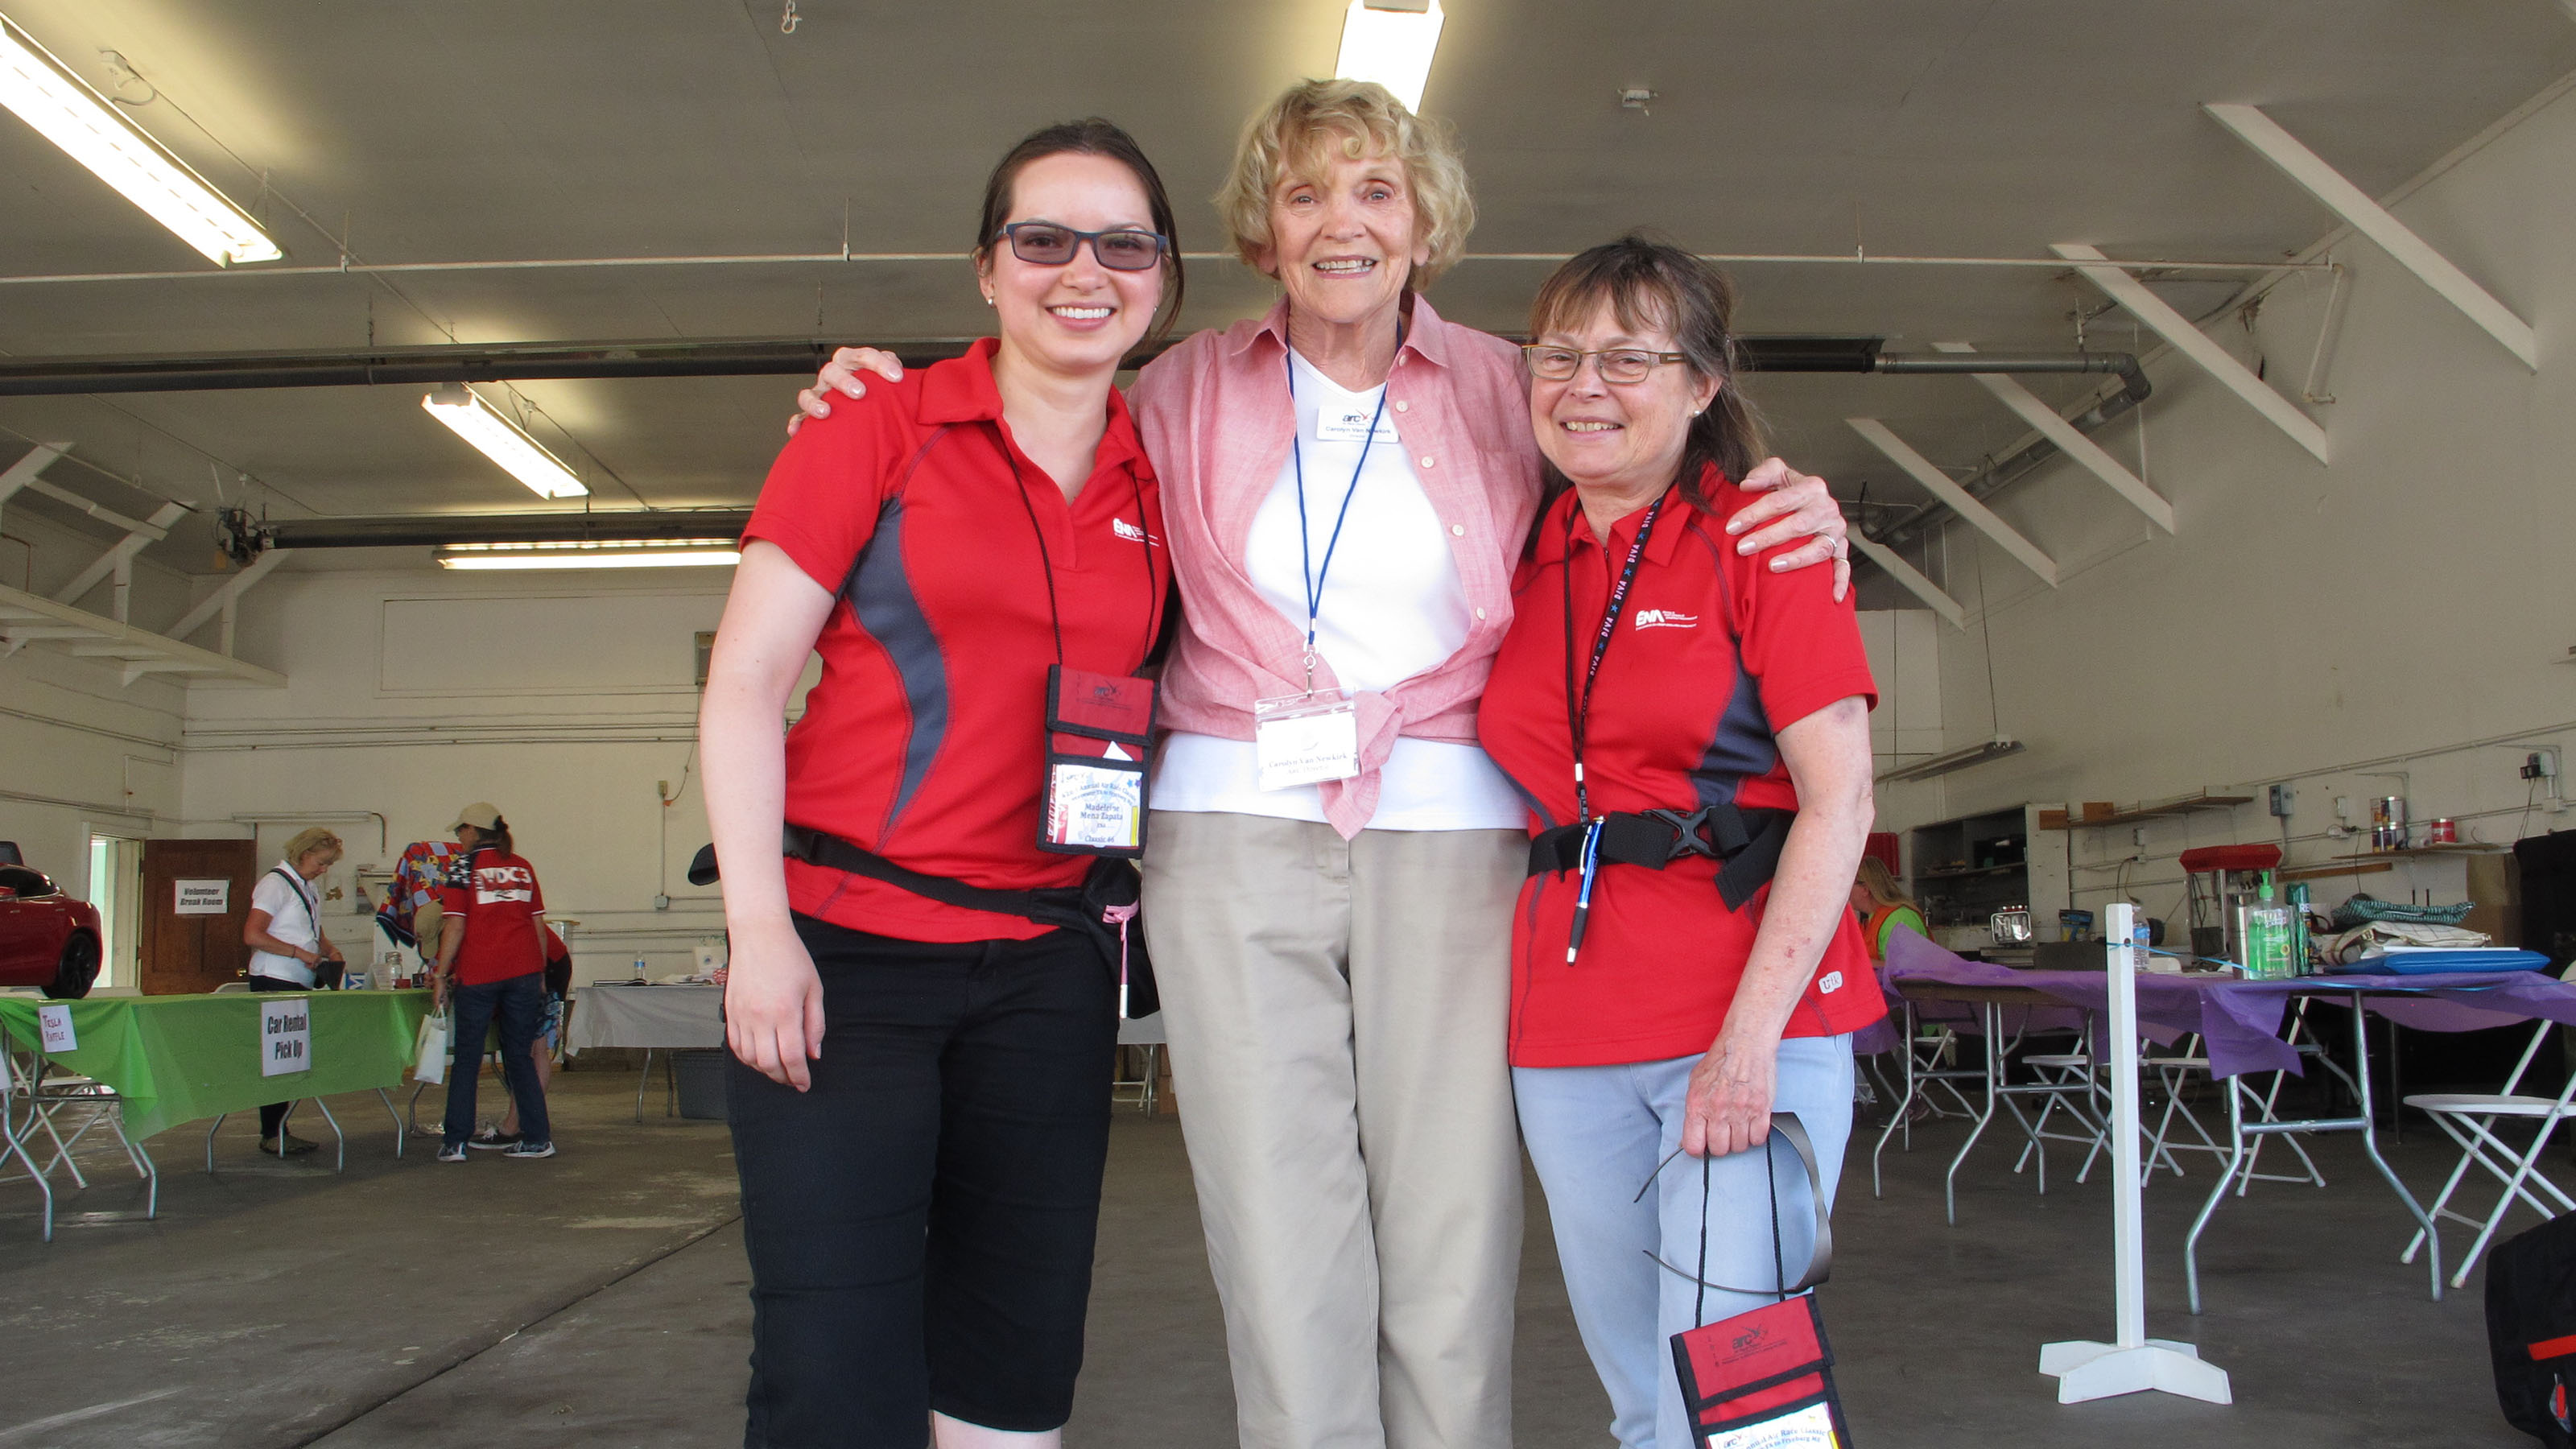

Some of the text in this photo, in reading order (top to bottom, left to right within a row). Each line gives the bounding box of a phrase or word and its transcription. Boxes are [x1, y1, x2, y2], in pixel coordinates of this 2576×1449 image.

[1343, 415, 1361, 423] arc
[1641, 511, 1654, 528] DIVA
[1627, 544, 1641, 564] DIVA
[1614, 580, 1627, 601] DIVA
[1601, 617, 1614, 638] DIVA
[1589, 655, 1600, 676] DIVA
[1269, 760, 1298, 768] Carolyn
[1316, 753, 1347, 762] Newkirk
[1084, 803, 1120, 812] Madeleine
[1080, 811, 1123, 822] Mena Zapata
[1084, 835, 1106, 843] Classic
[184, 888, 220, 896] Volunteer
[267, 1013, 308, 1034] Car Rental
[275, 1039, 303, 1060] Pick Up
